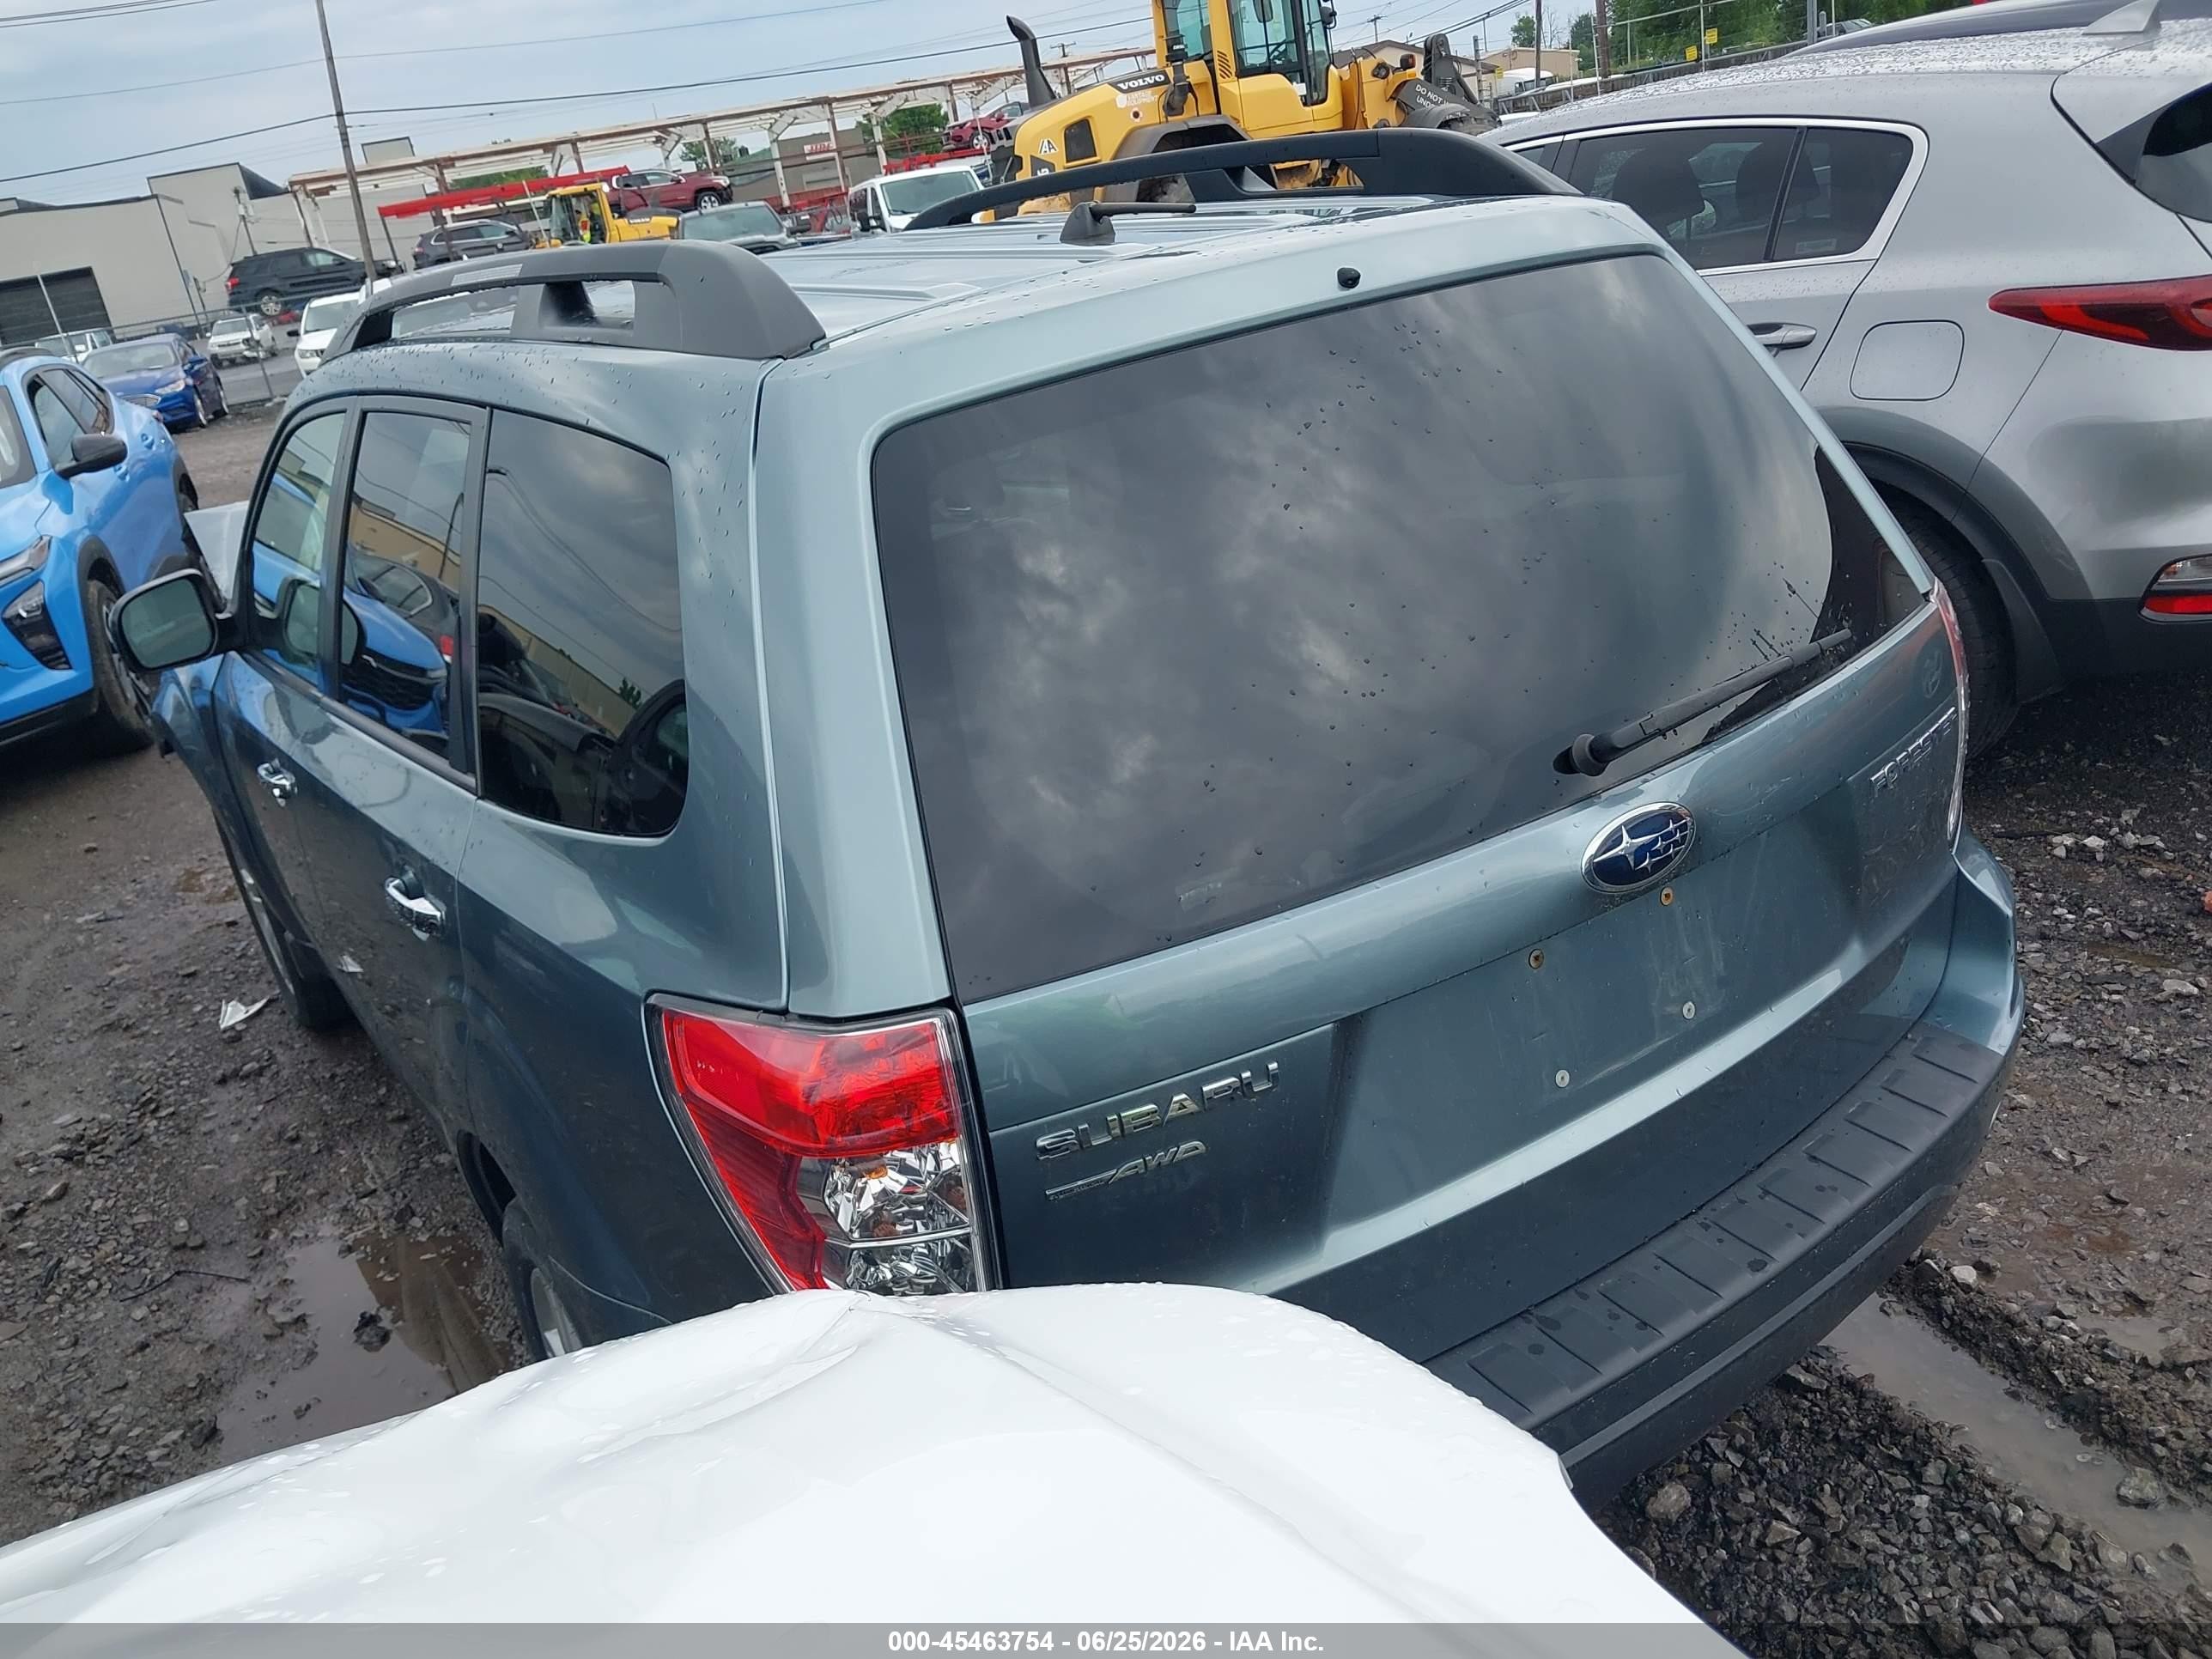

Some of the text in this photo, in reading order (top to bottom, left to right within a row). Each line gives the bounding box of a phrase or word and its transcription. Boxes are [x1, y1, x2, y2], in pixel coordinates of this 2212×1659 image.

[1117, 74, 1165, 90] VOLVO
[1415, 84, 1427, 95] DO
[1427, 90, 1443, 104] NOT
[1034, 1060, 1279, 1162] SUBARU
[1109, 1139, 1208, 1184] AWD
